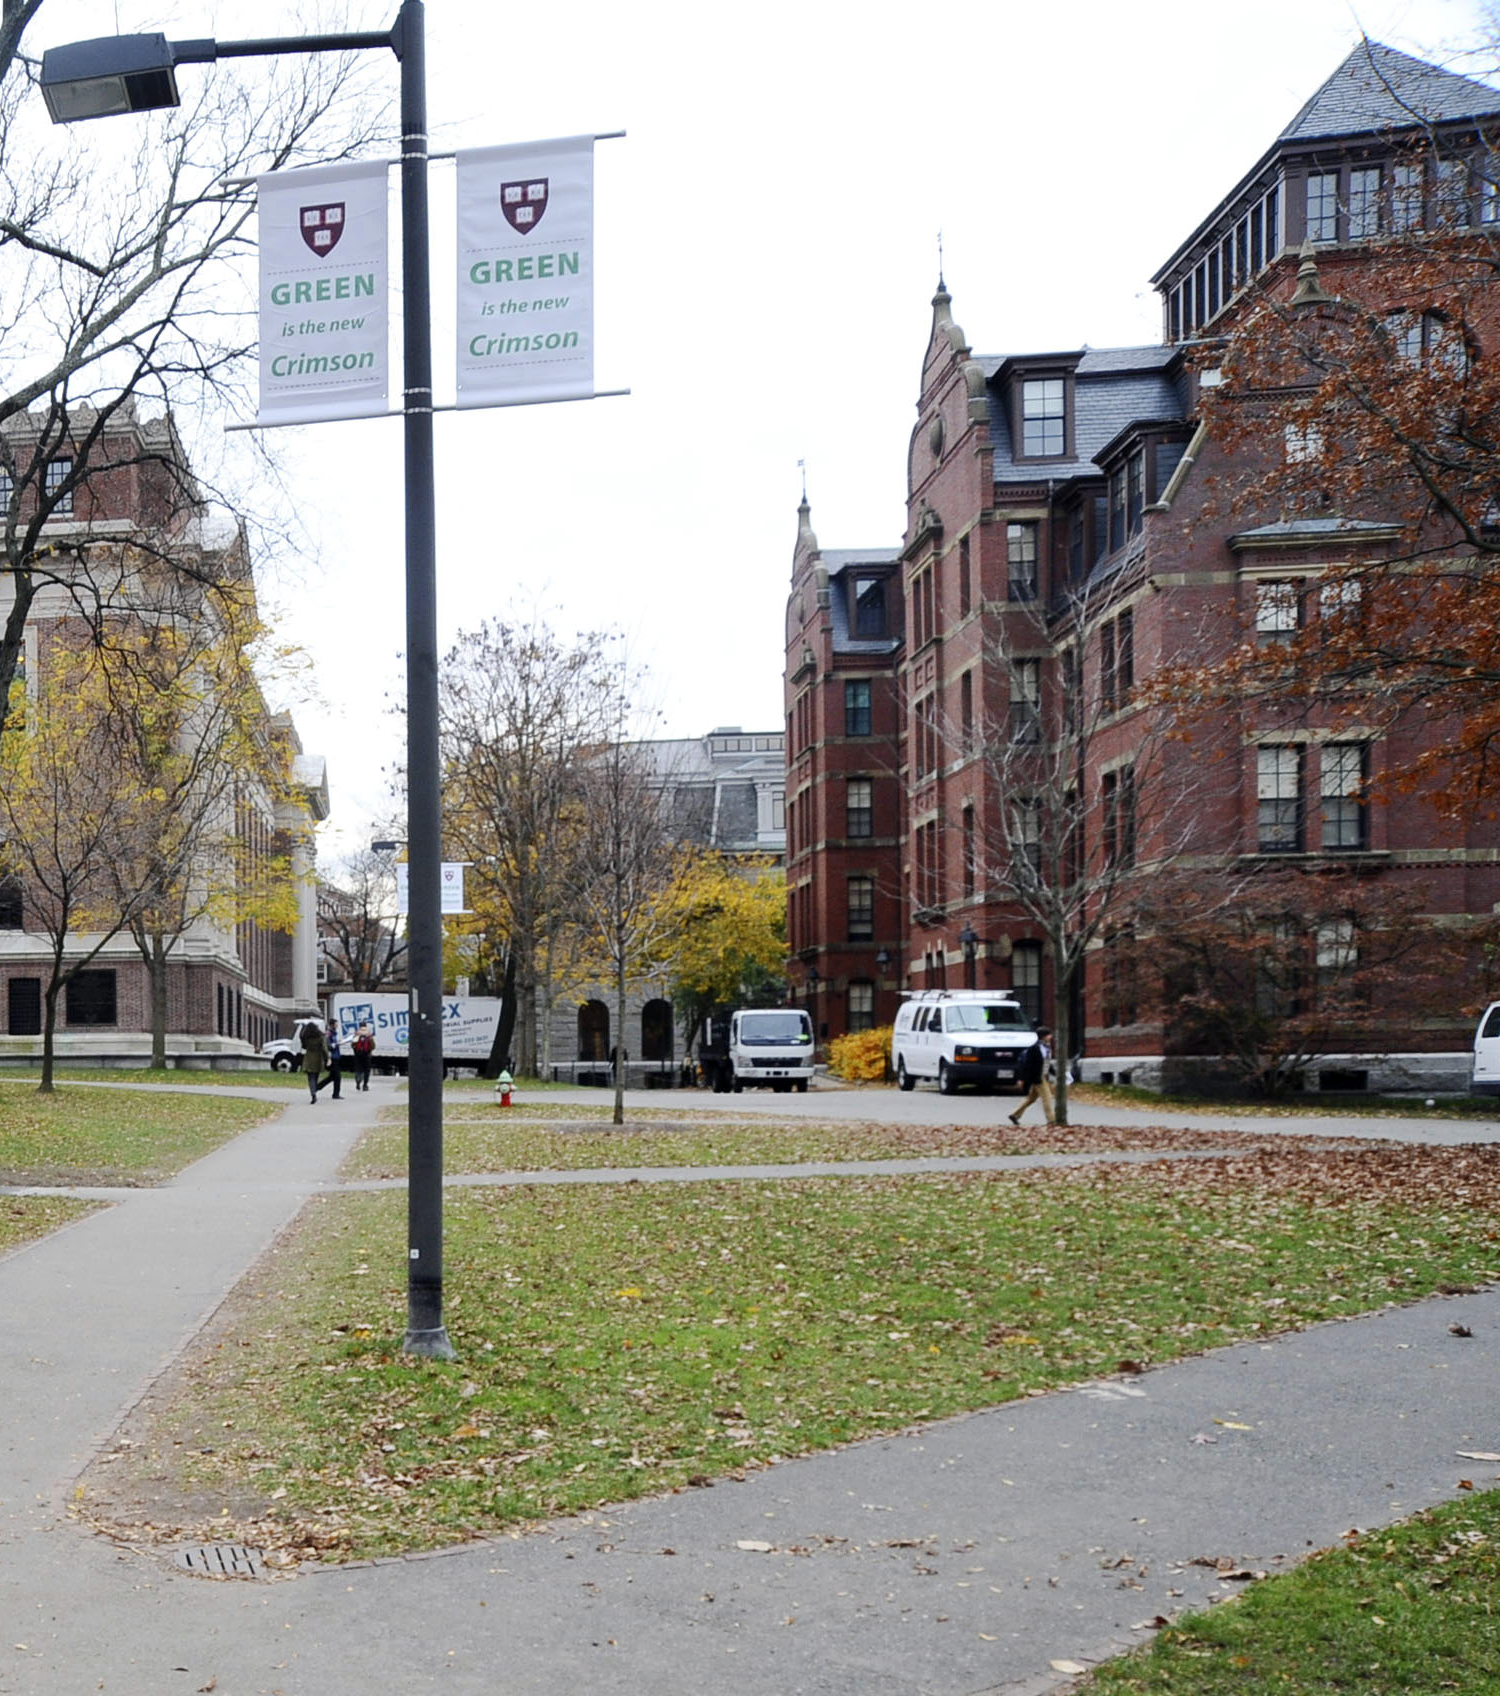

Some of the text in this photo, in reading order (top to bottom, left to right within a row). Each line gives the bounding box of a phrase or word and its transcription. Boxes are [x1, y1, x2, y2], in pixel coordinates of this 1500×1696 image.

[469, 251, 579, 285] GREEN
[271, 273, 375, 306] GREEN
[481, 296, 570, 316] is the new
[282, 317, 366, 337] is the new
[469, 330, 579, 357] Crimson
[271, 351, 375, 377] Crimson
